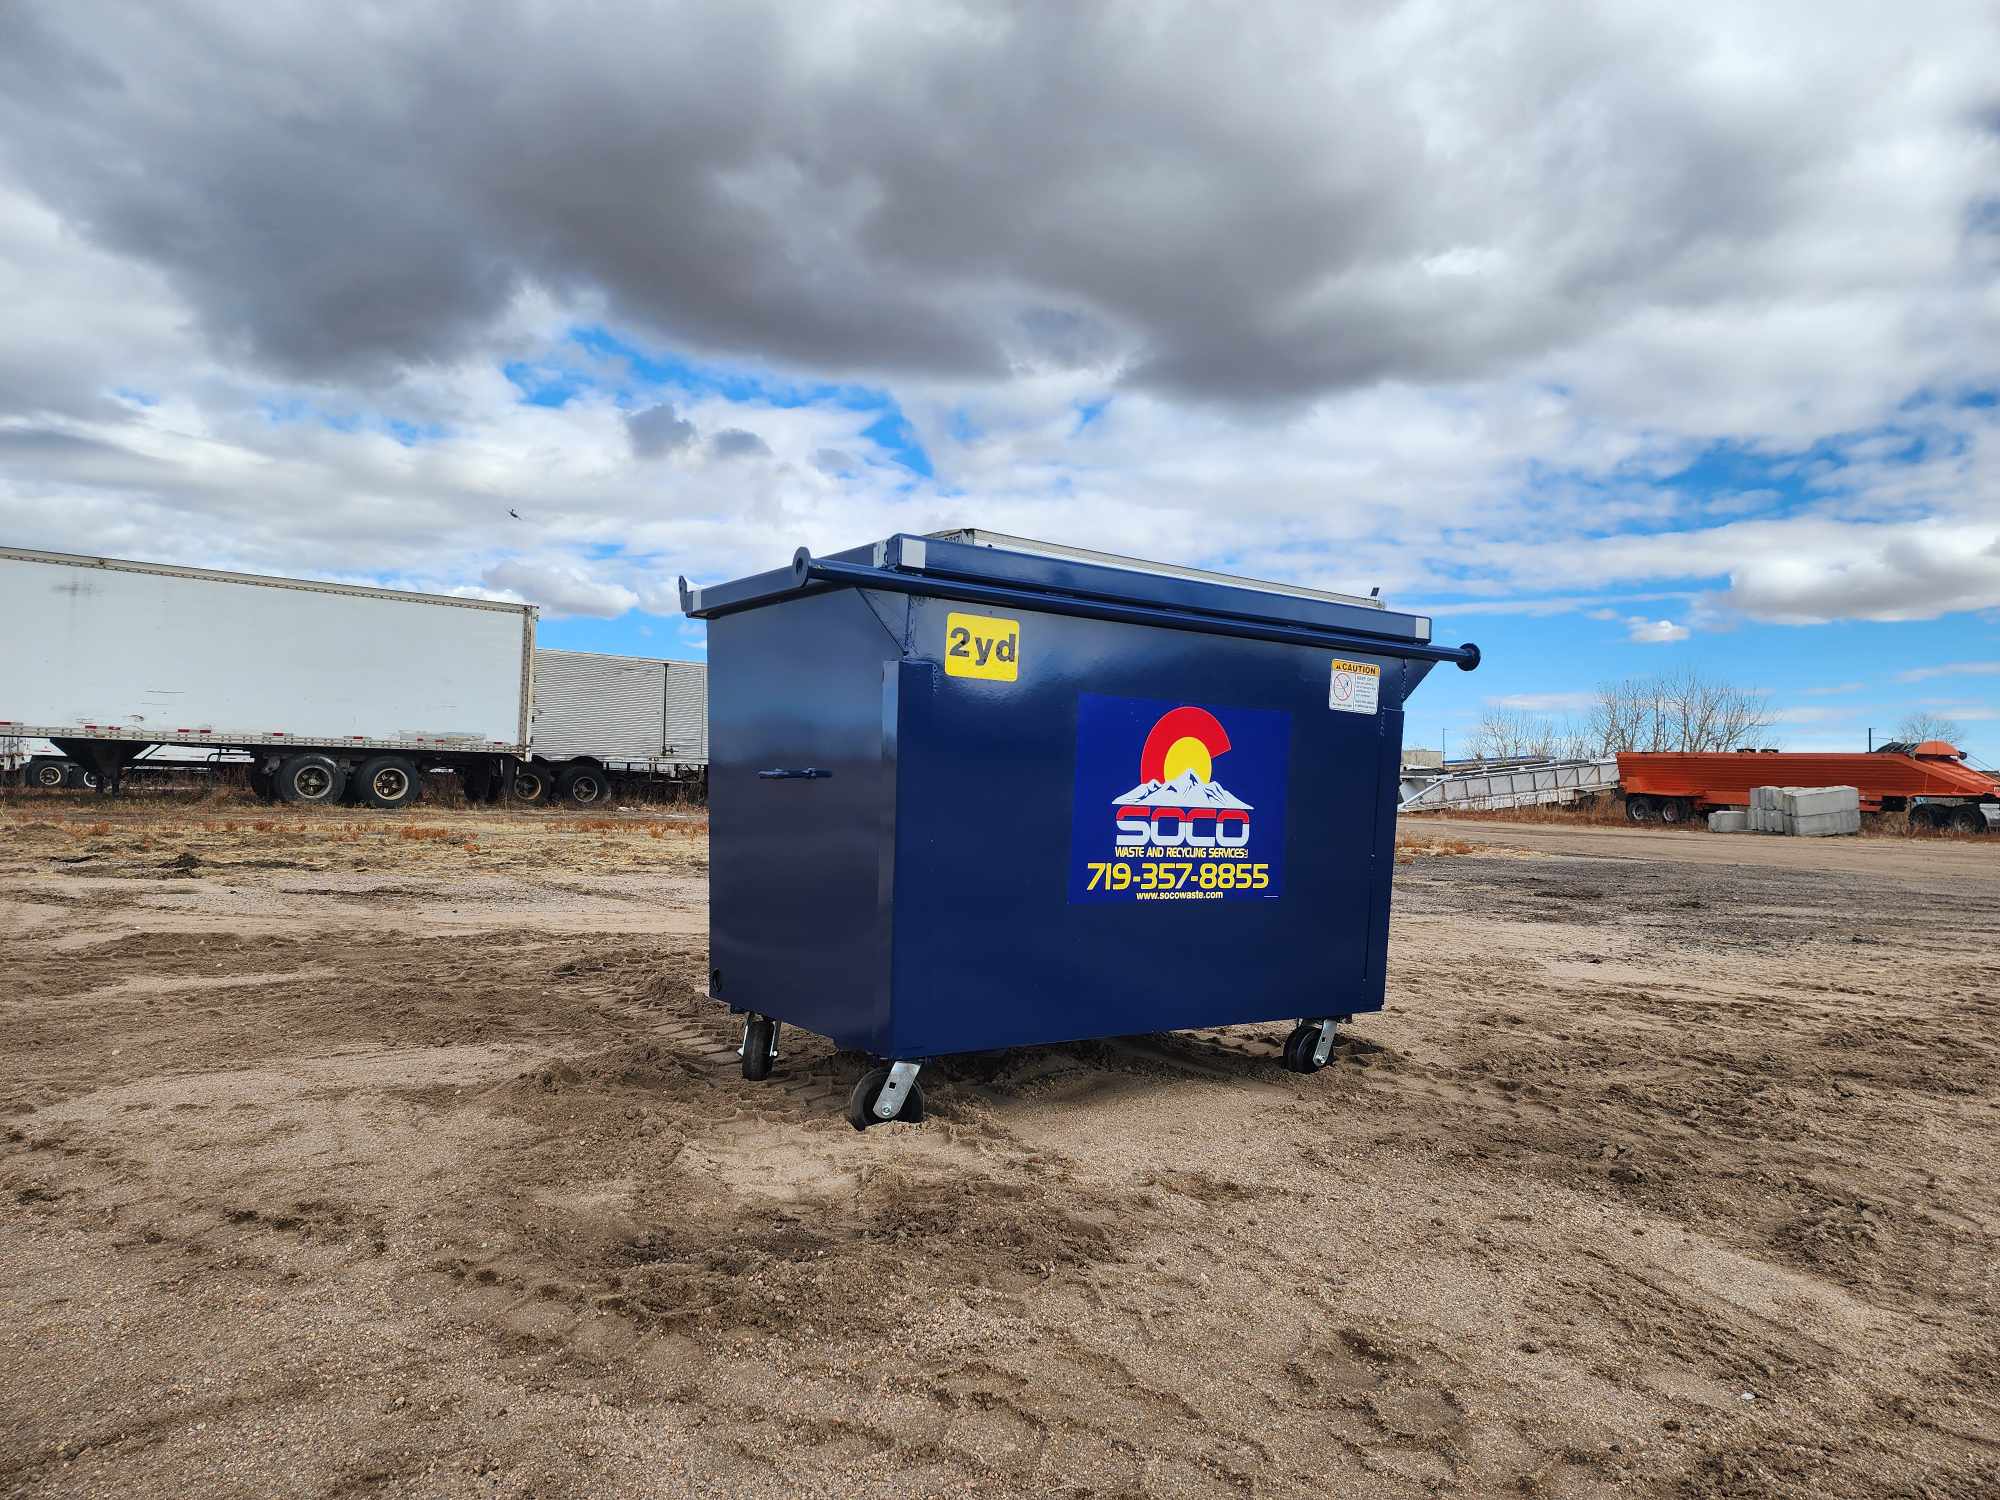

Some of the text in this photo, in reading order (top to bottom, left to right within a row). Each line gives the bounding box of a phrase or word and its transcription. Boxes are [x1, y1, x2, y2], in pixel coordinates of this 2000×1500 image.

[949, 627, 1016, 666] 2yd
[1342, 663, 1376, 674] CAUTION
[1115, 806, 1250, 847] SOCO
[1115, 846, 1144, 858] WASTE
[1146, 847, 1163, 858] AND
[1166, 847, 1206, 858] RECYCLING
[1208, 848, 1244, 858] SERVICES
[1087, 863, 1269, 890] 719-357-8855
[1136, 890, 1223, 900] www.socowaste.com
